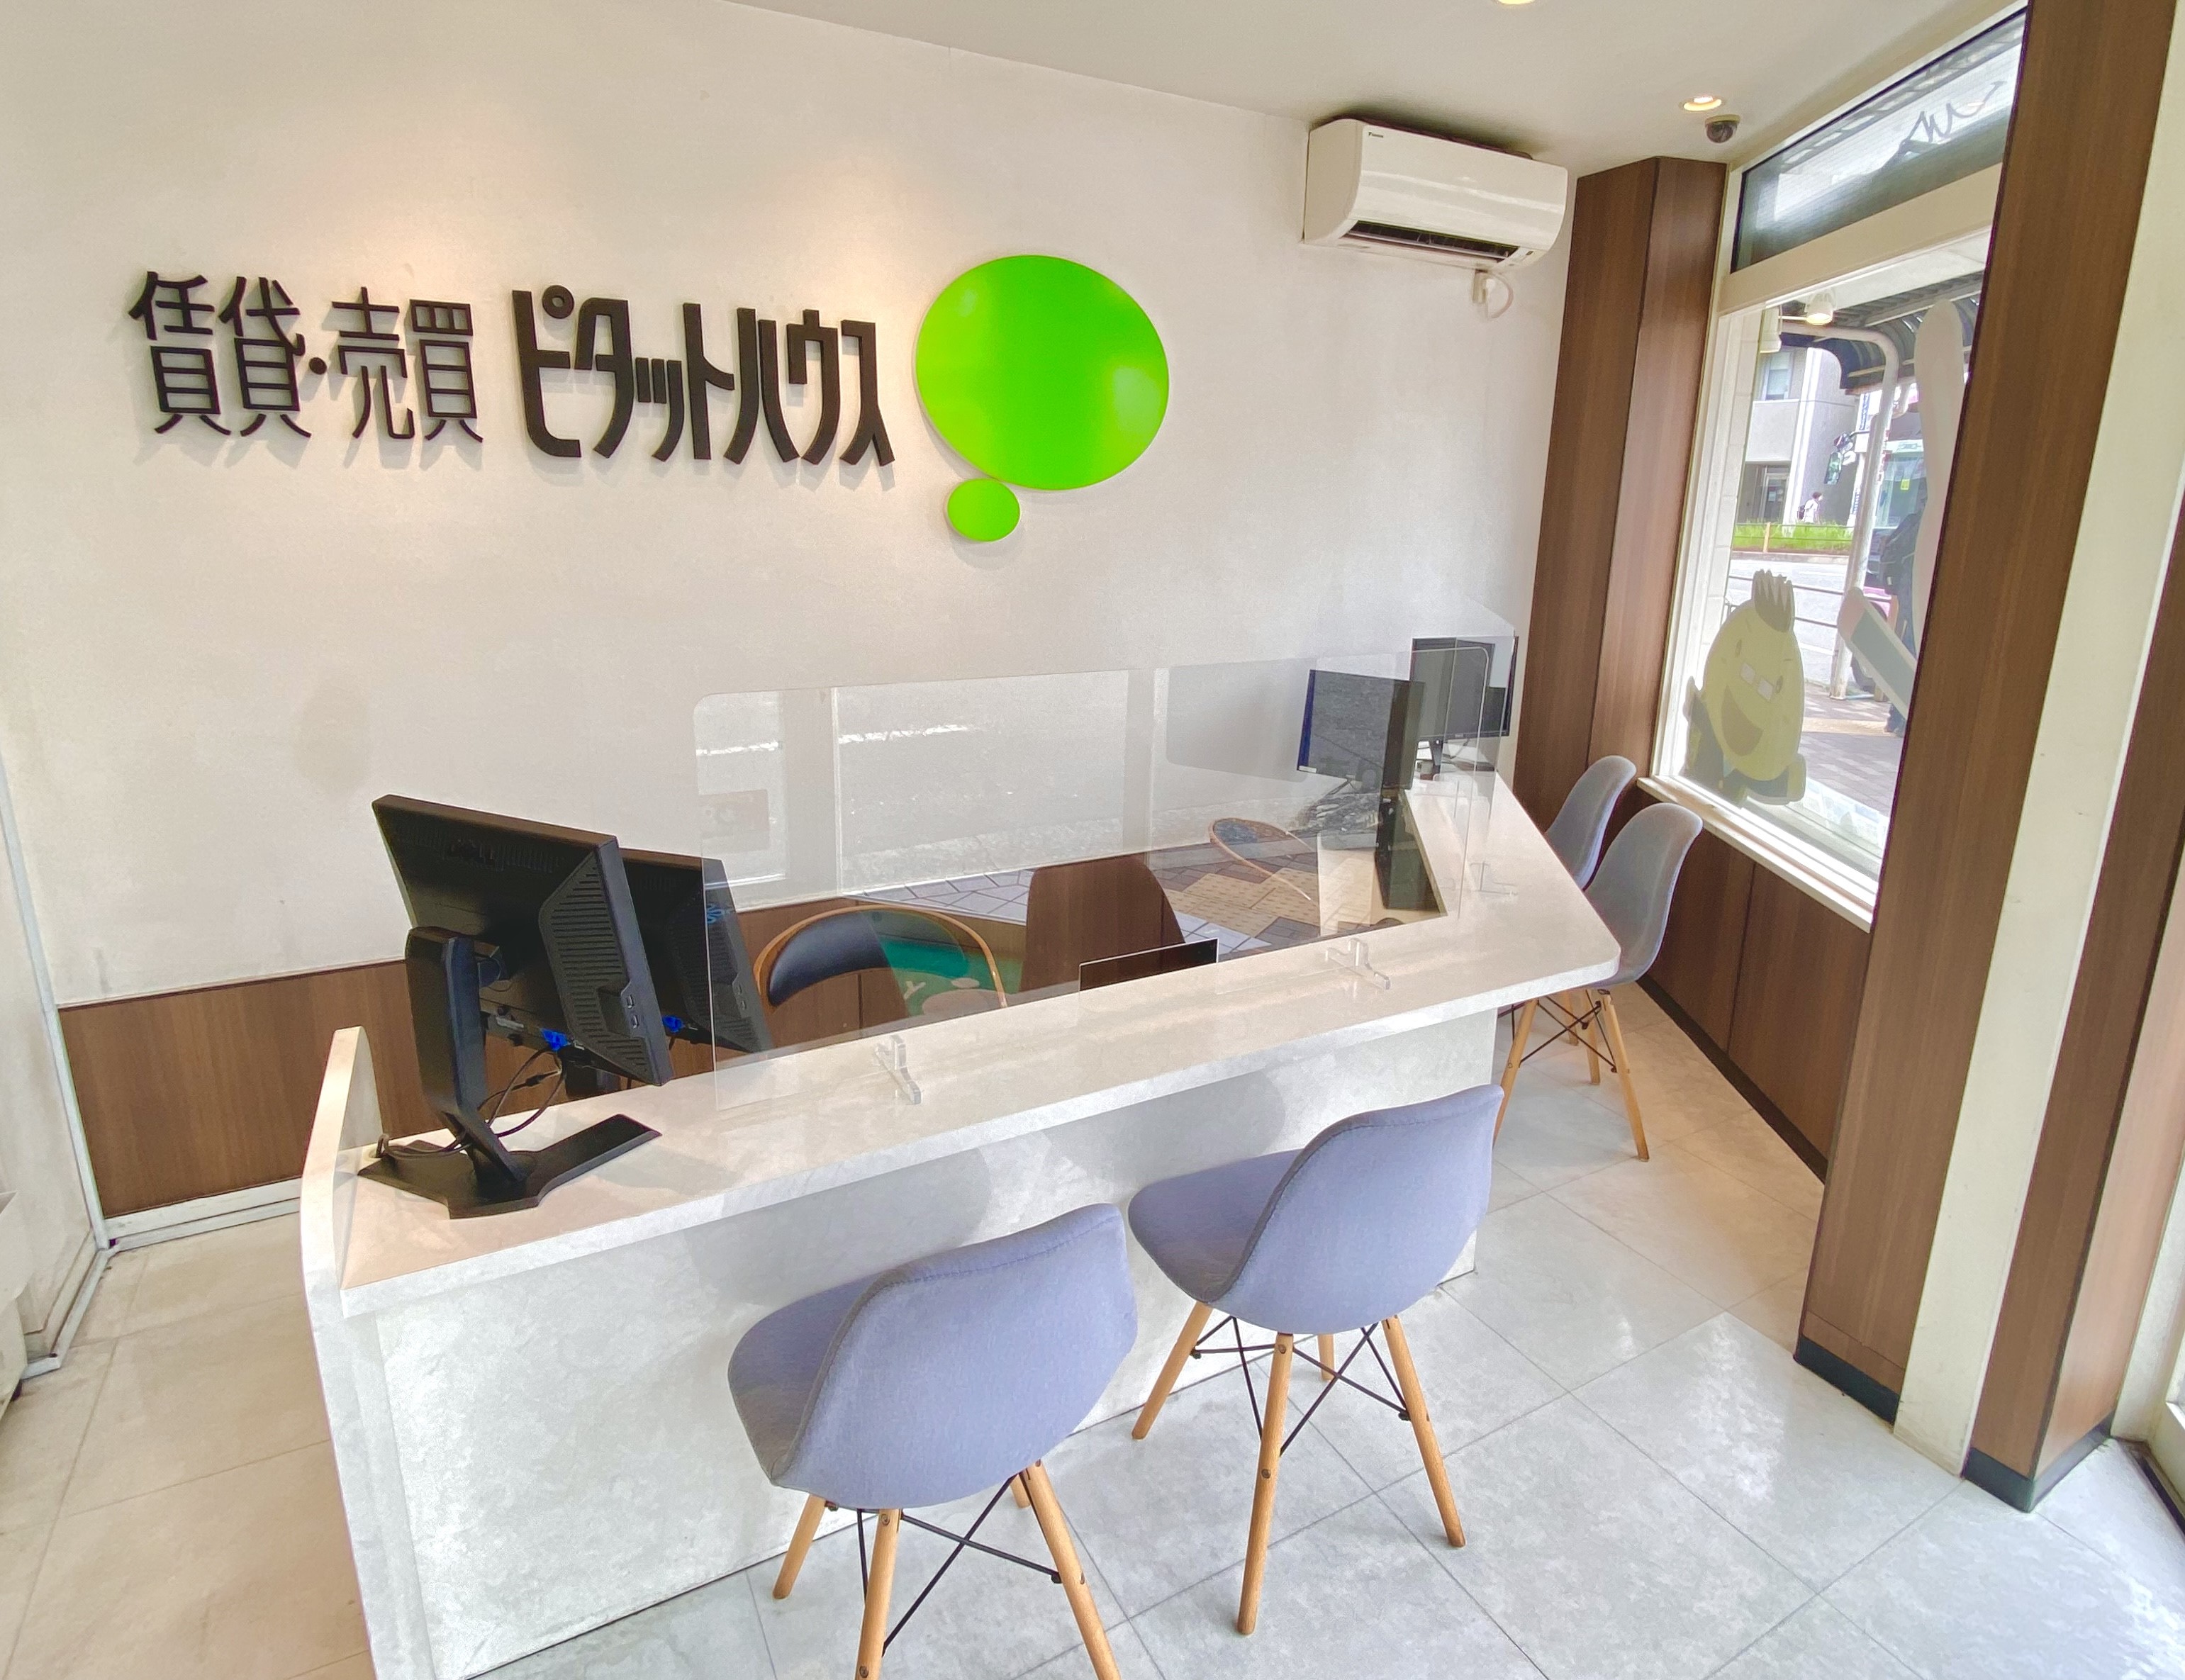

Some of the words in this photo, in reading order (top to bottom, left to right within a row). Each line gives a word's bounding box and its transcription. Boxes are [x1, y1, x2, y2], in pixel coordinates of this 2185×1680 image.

[512, 284, 894, 467] ピタットハウス
